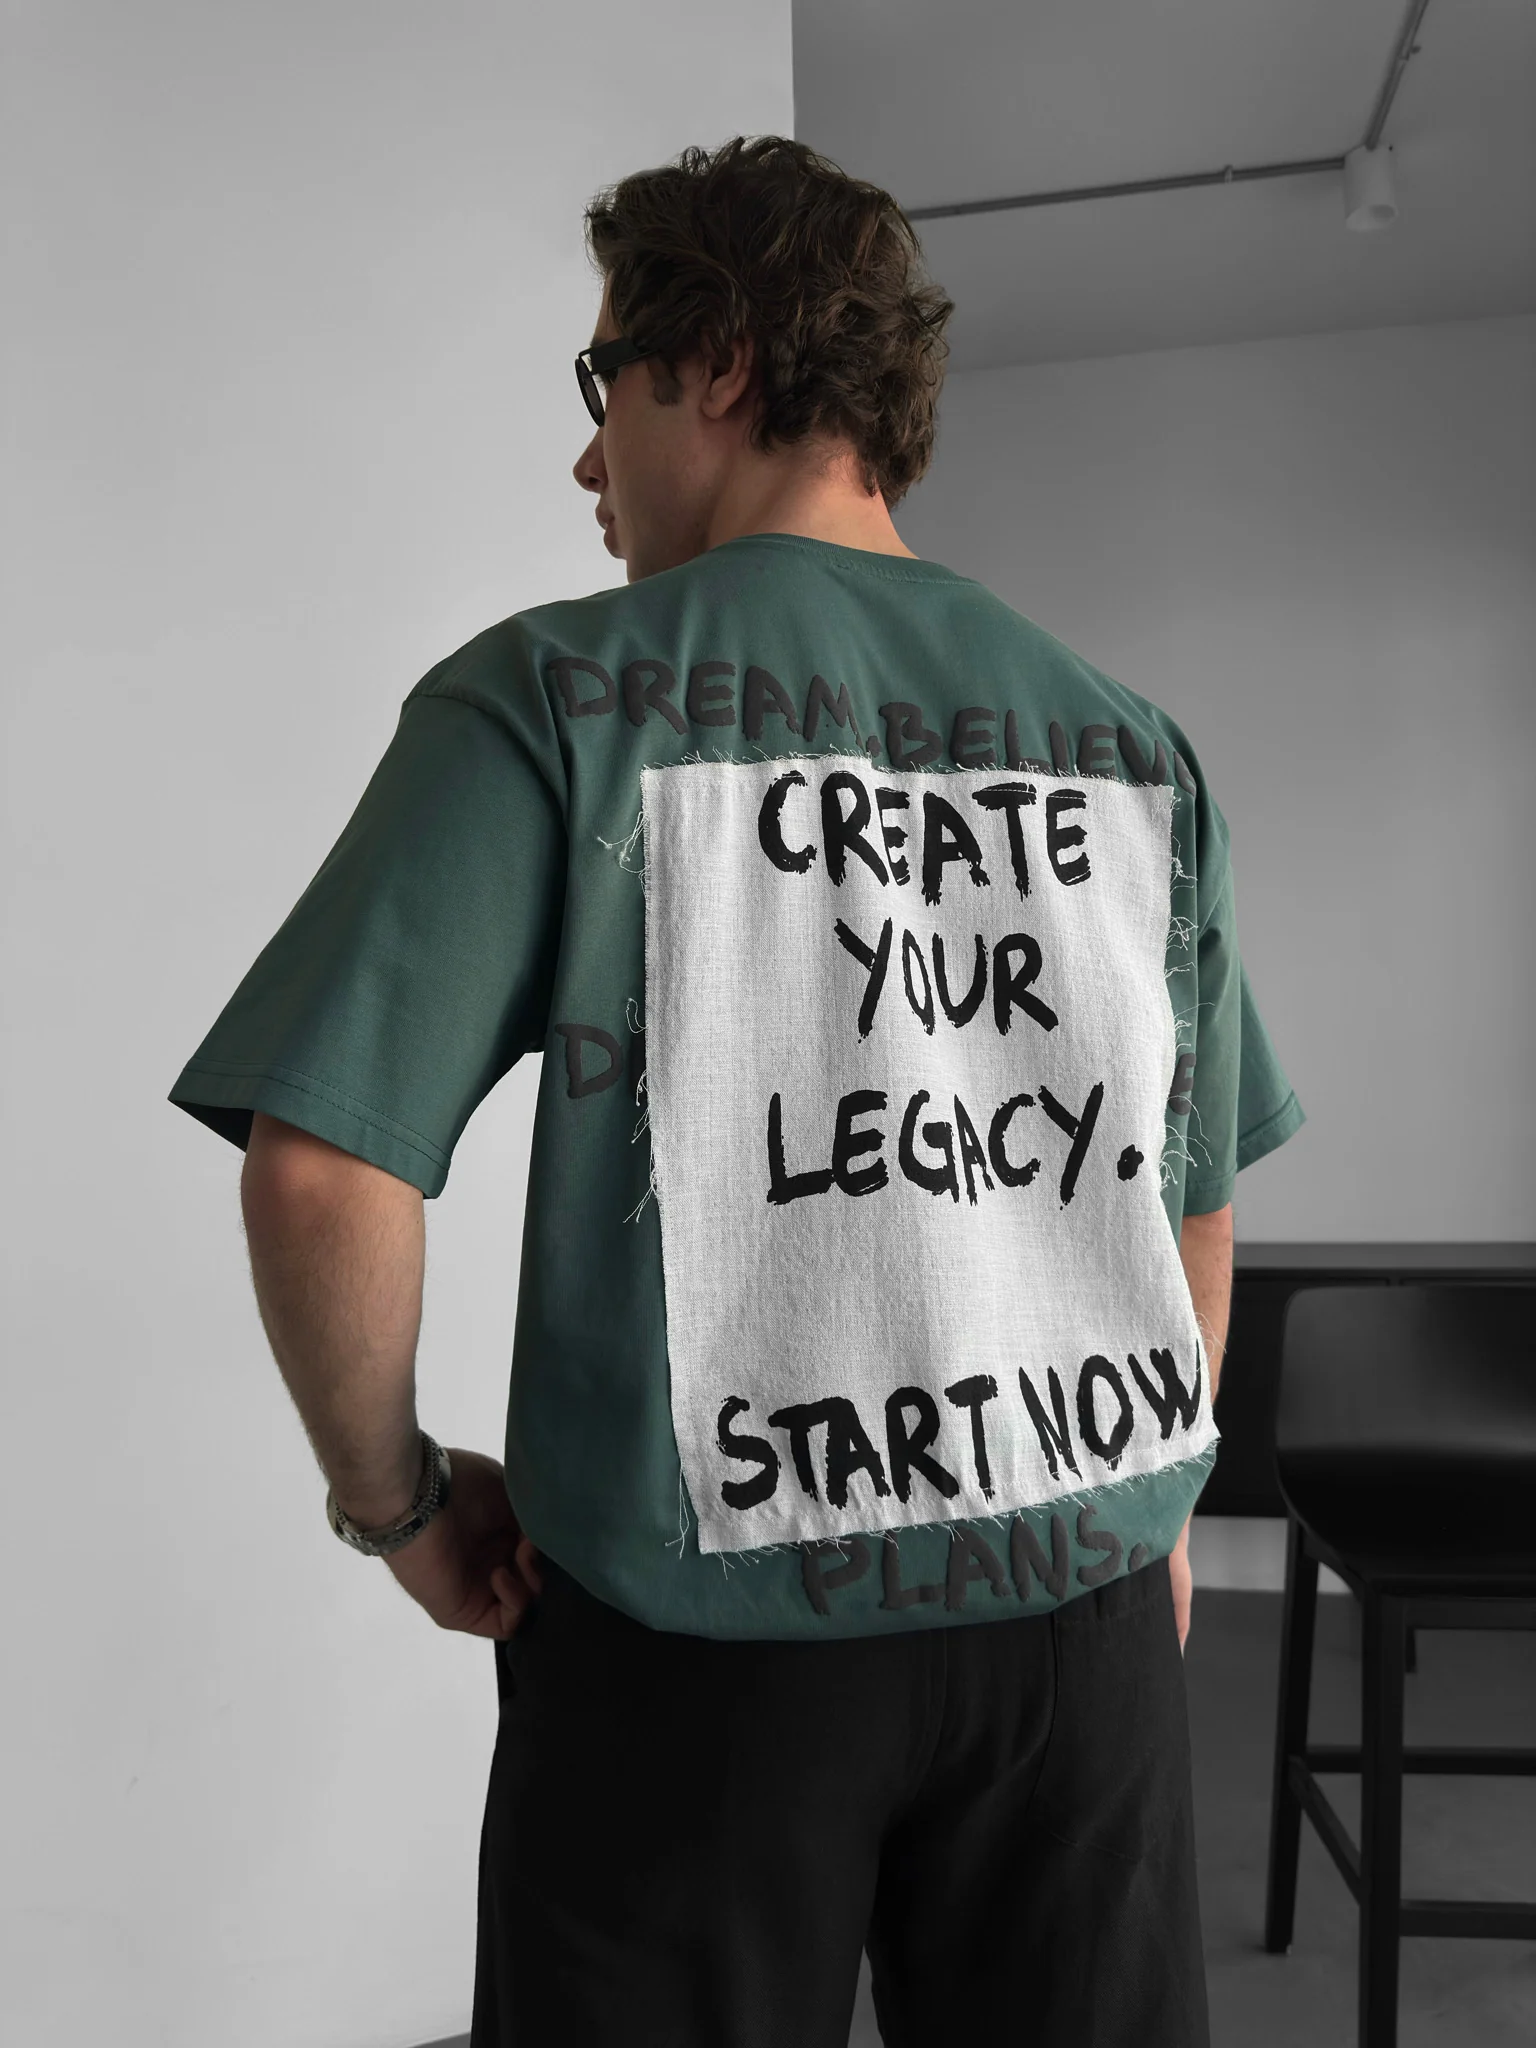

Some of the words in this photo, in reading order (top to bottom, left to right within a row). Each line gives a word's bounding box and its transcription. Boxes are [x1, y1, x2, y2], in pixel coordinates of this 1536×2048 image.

[758, 770, 1093, 905] CREATE
[833, 917, 1059, 1043] YOUR
[766, 1081, 1144, 1210] LEGACY.
[716, 1374, 1000, 1510] START
[1018, 1338, 1204, 1482] NOW
